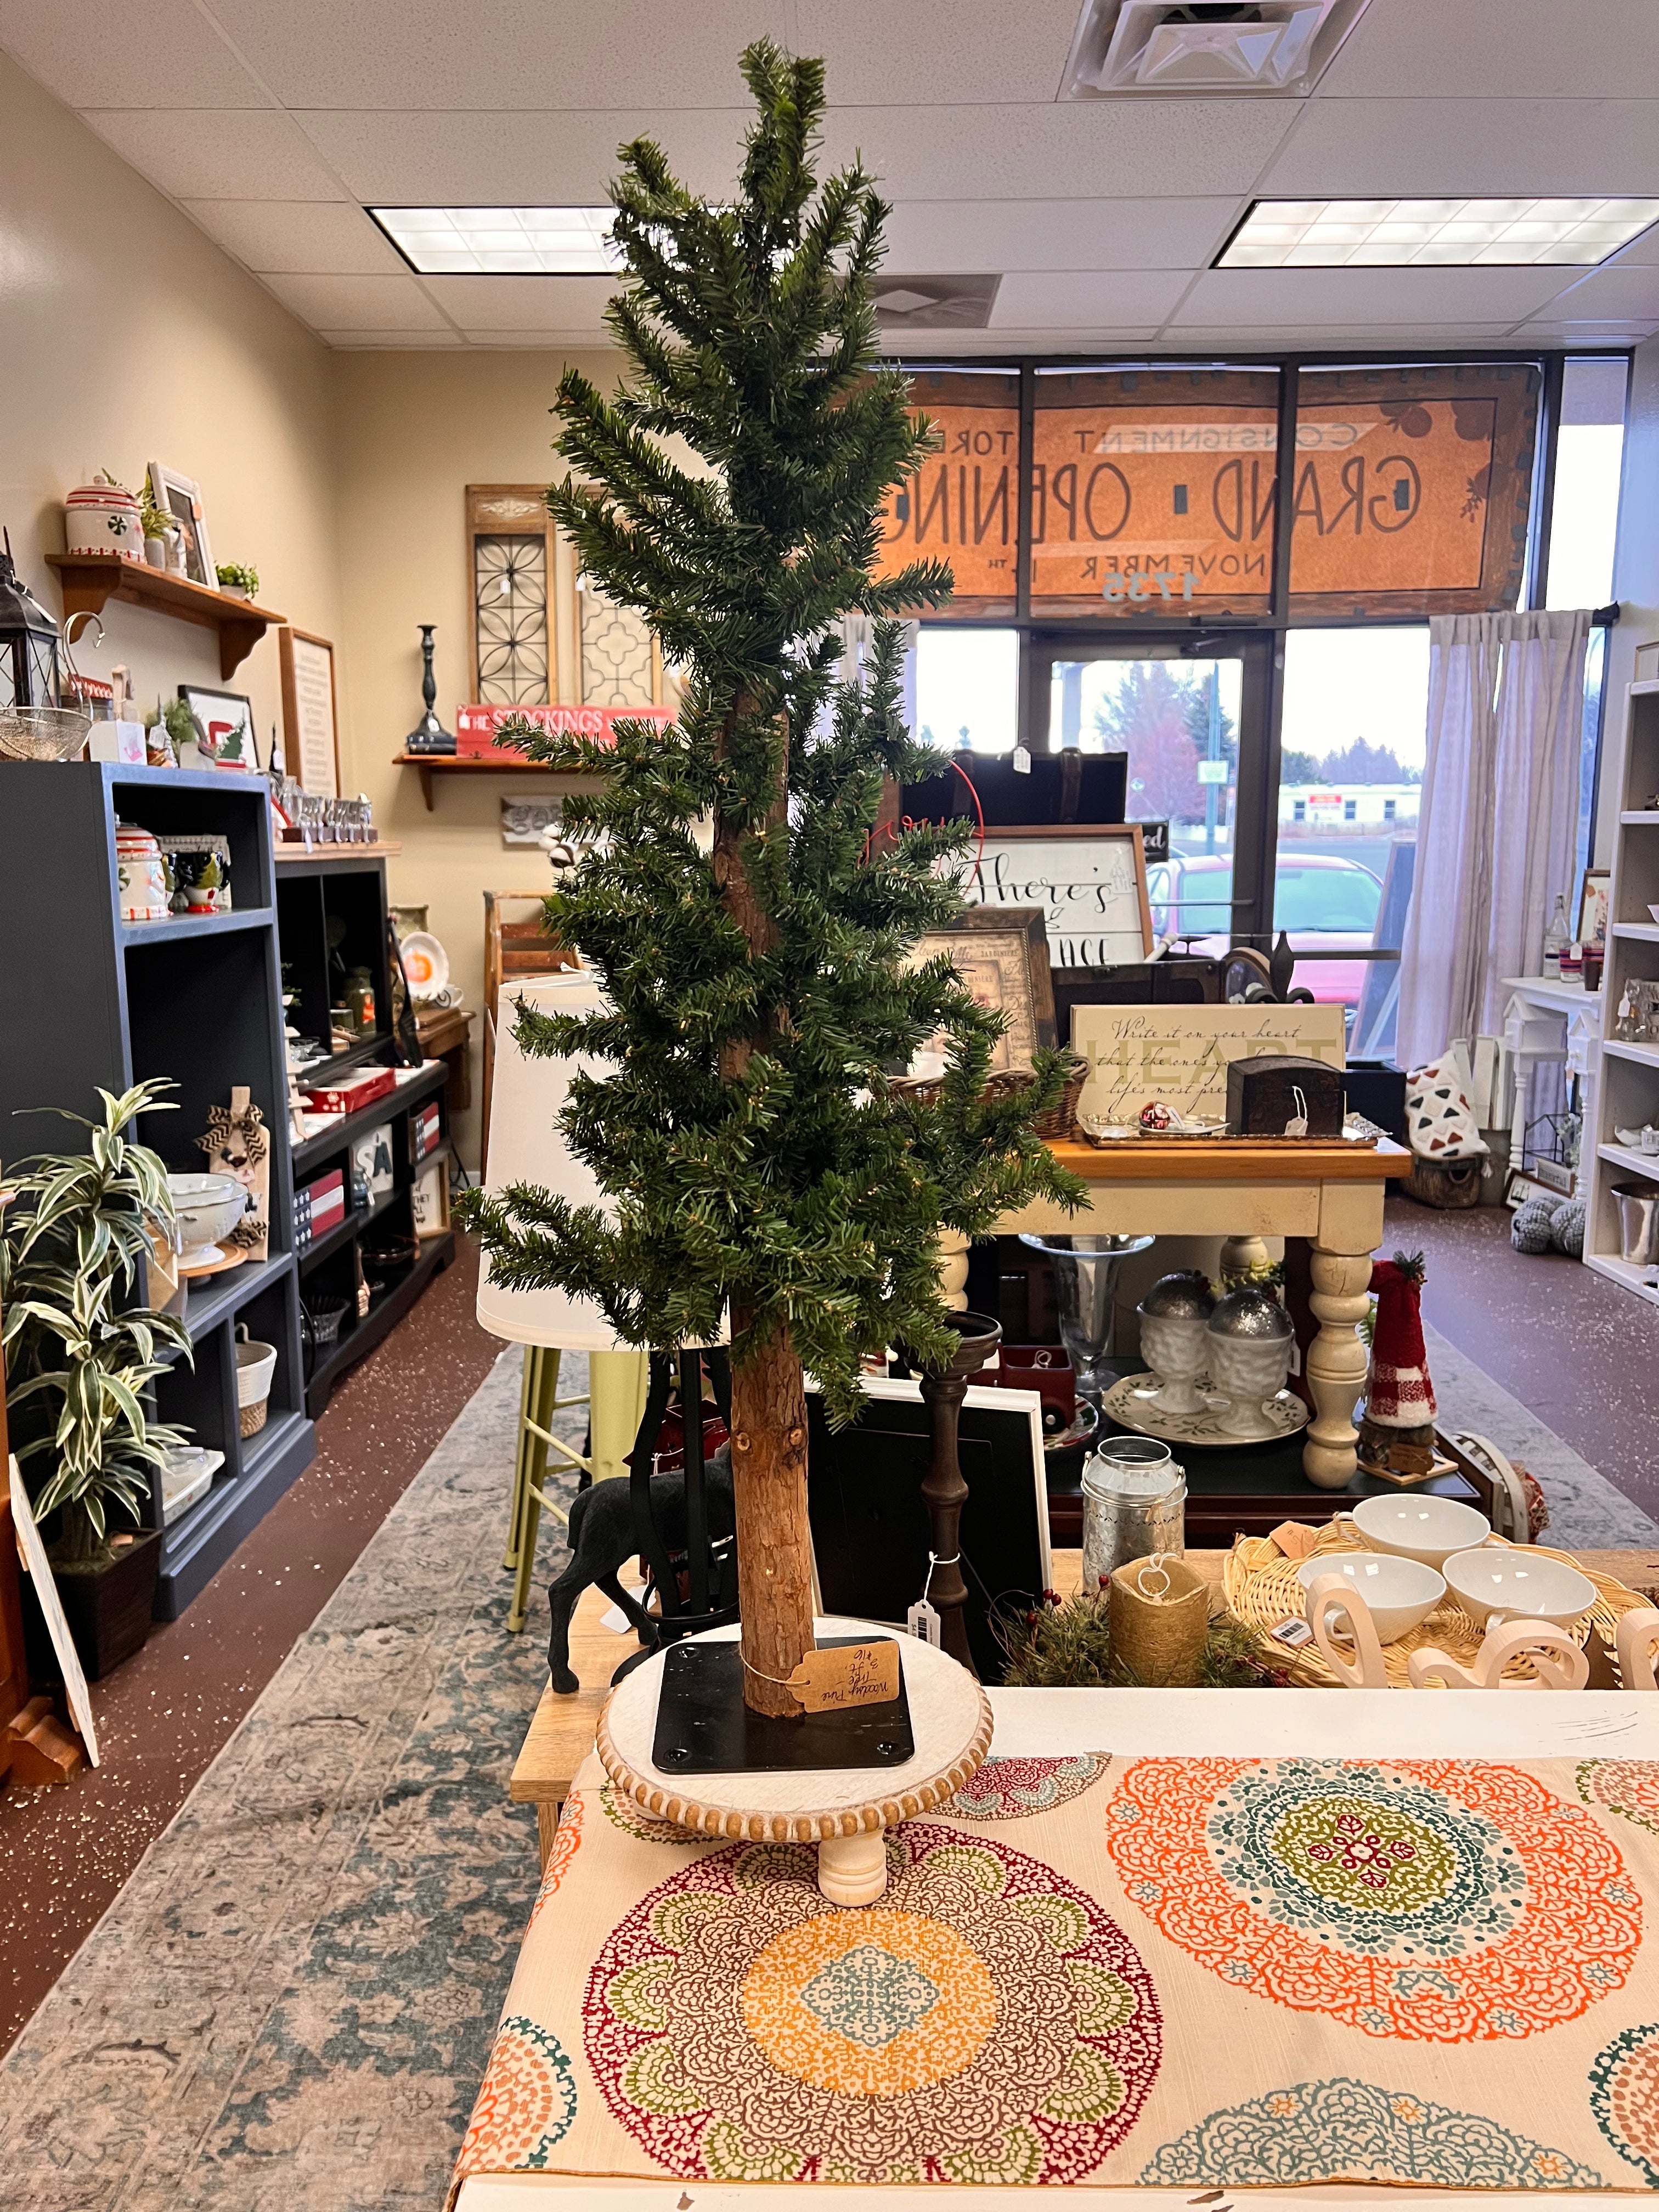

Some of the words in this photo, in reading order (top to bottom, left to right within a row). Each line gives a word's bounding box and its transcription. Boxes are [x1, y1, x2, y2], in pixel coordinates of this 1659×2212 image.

[1143, 826, 1166, 849] ed
[955, 853, 1118, 914] There's
[1060, 938, 1110, 966] ACE
[1111, 1015, 1159, 1040] Write
[1164, 1025, 1182, 1039] it
[1203, 1030, 1249, 1058] your
[1251, 1019, 1304, 1039] heart
[1097, 1047, 1138, 1066] that
[1138, 1047, 1166, 1066] the
[1171, 1057, 1207, 1066] ones
[1204, 1059, 1230, 1086] yo
[1150, 1080, 1195, 1094] most
[854, 1649, 873, 1661] $16
[870, 1658, 879, 1669] 3
[821, 1690, 848, 1704] Pine
